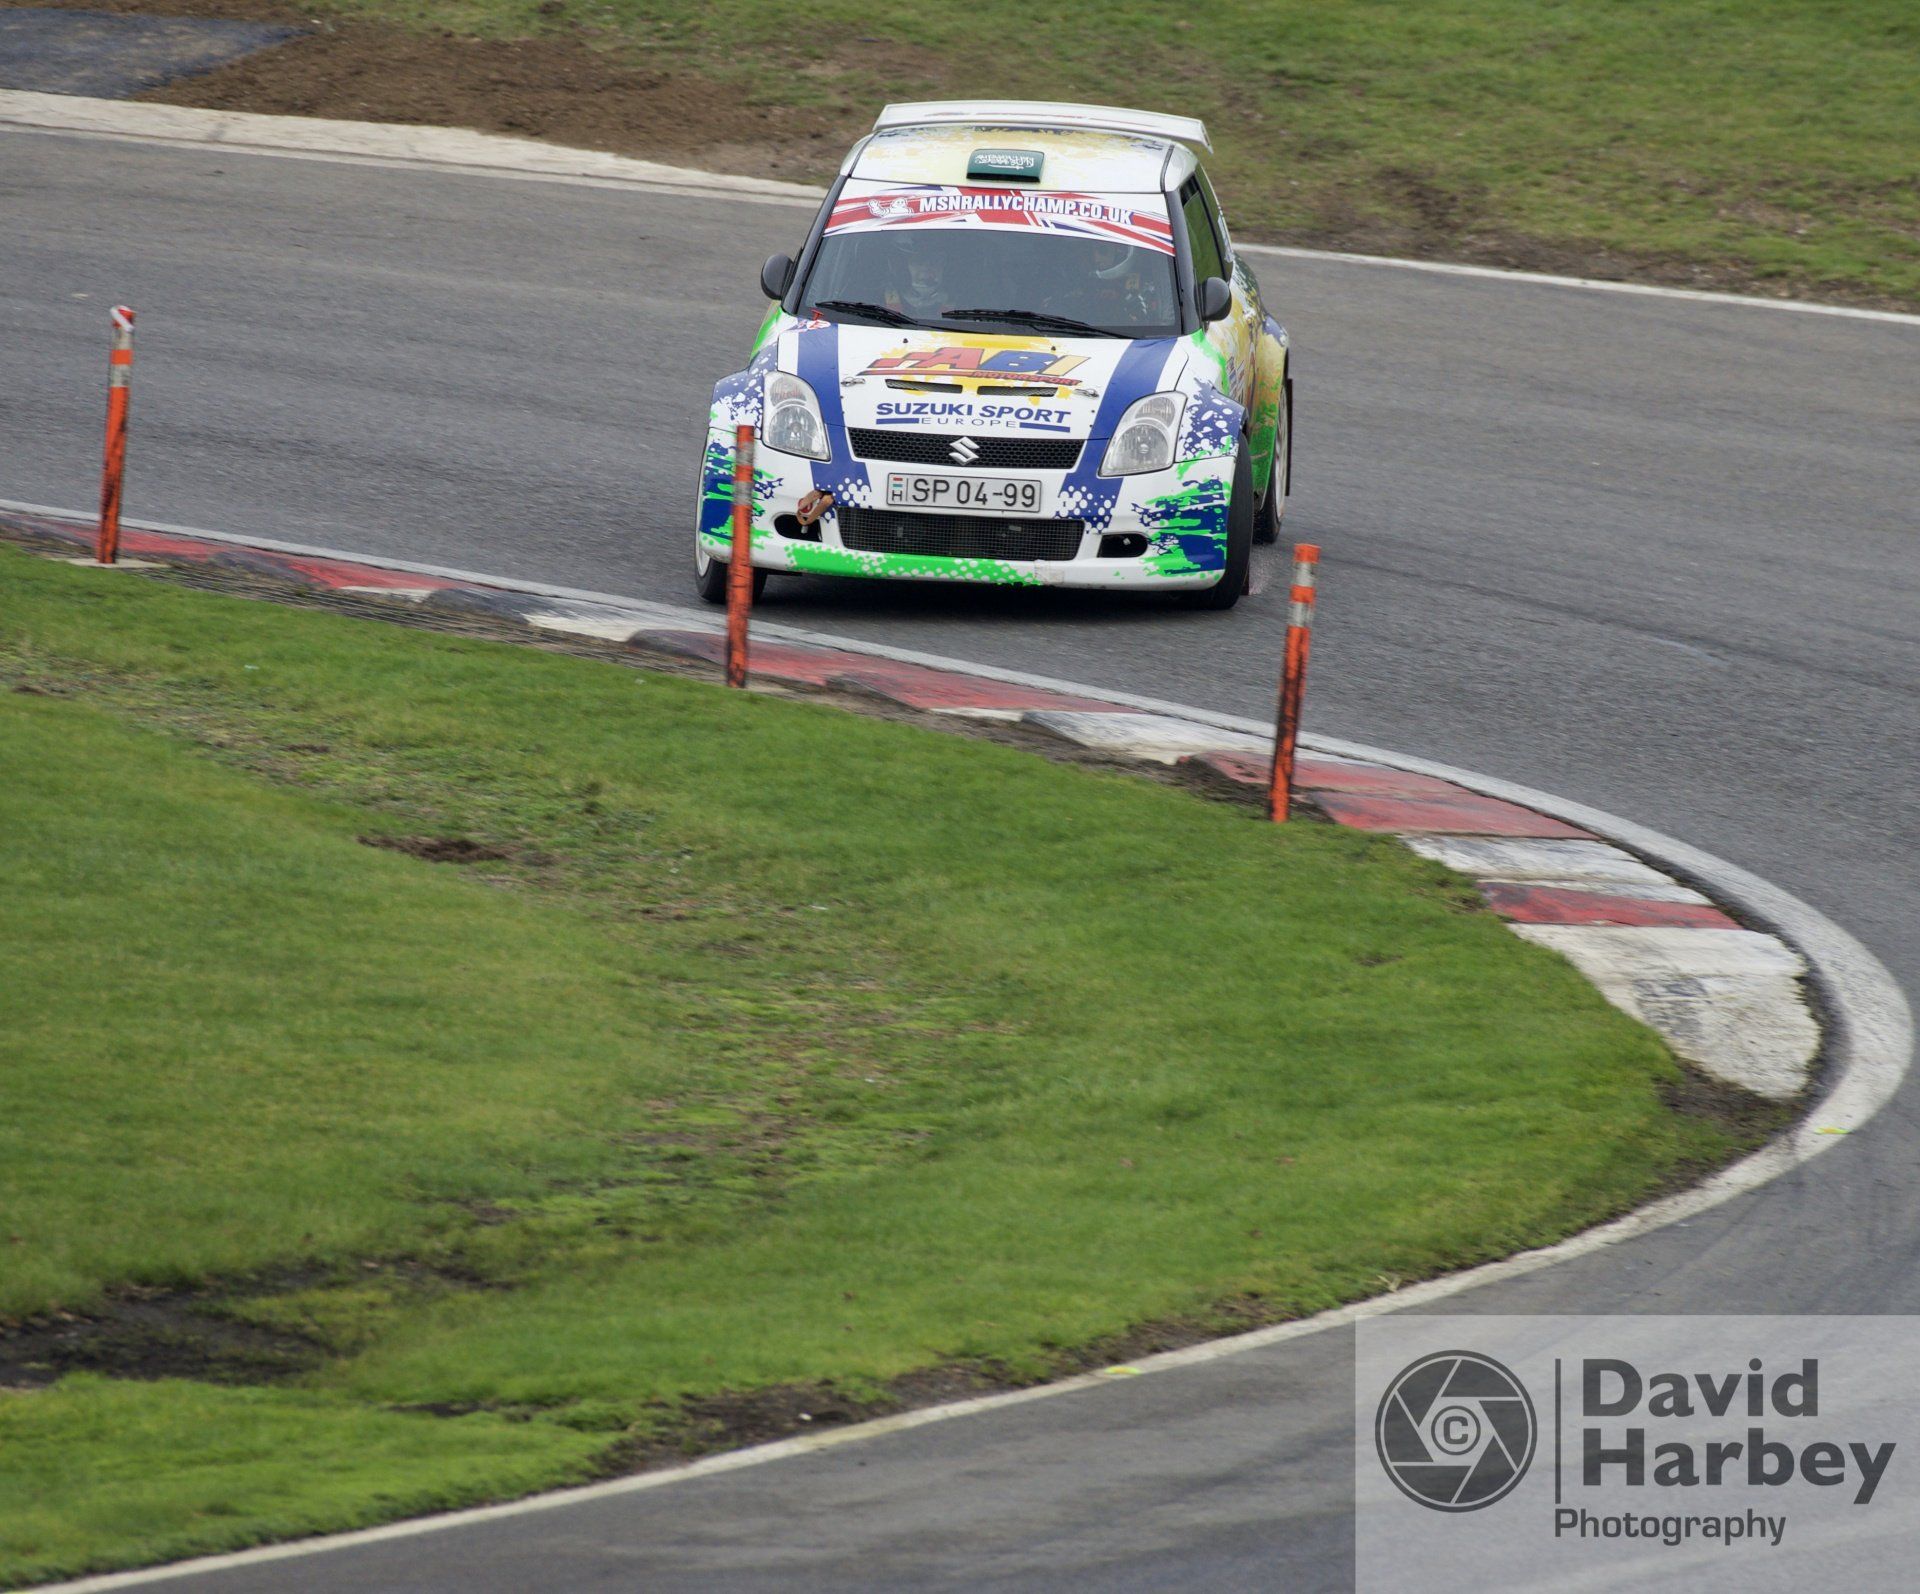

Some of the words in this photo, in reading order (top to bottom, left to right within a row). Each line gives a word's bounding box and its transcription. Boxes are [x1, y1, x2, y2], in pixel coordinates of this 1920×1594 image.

[919, 195, 1132, 225] MSNRALLYCHAMP.CO.UK
[971, 370, 1083, 387] MOTORSPORT
[876, 403, 973, 416] SUZUKI
[979, 405, 1071, 424] SPORT
[921, 417, 1016, 428] EUROPE
